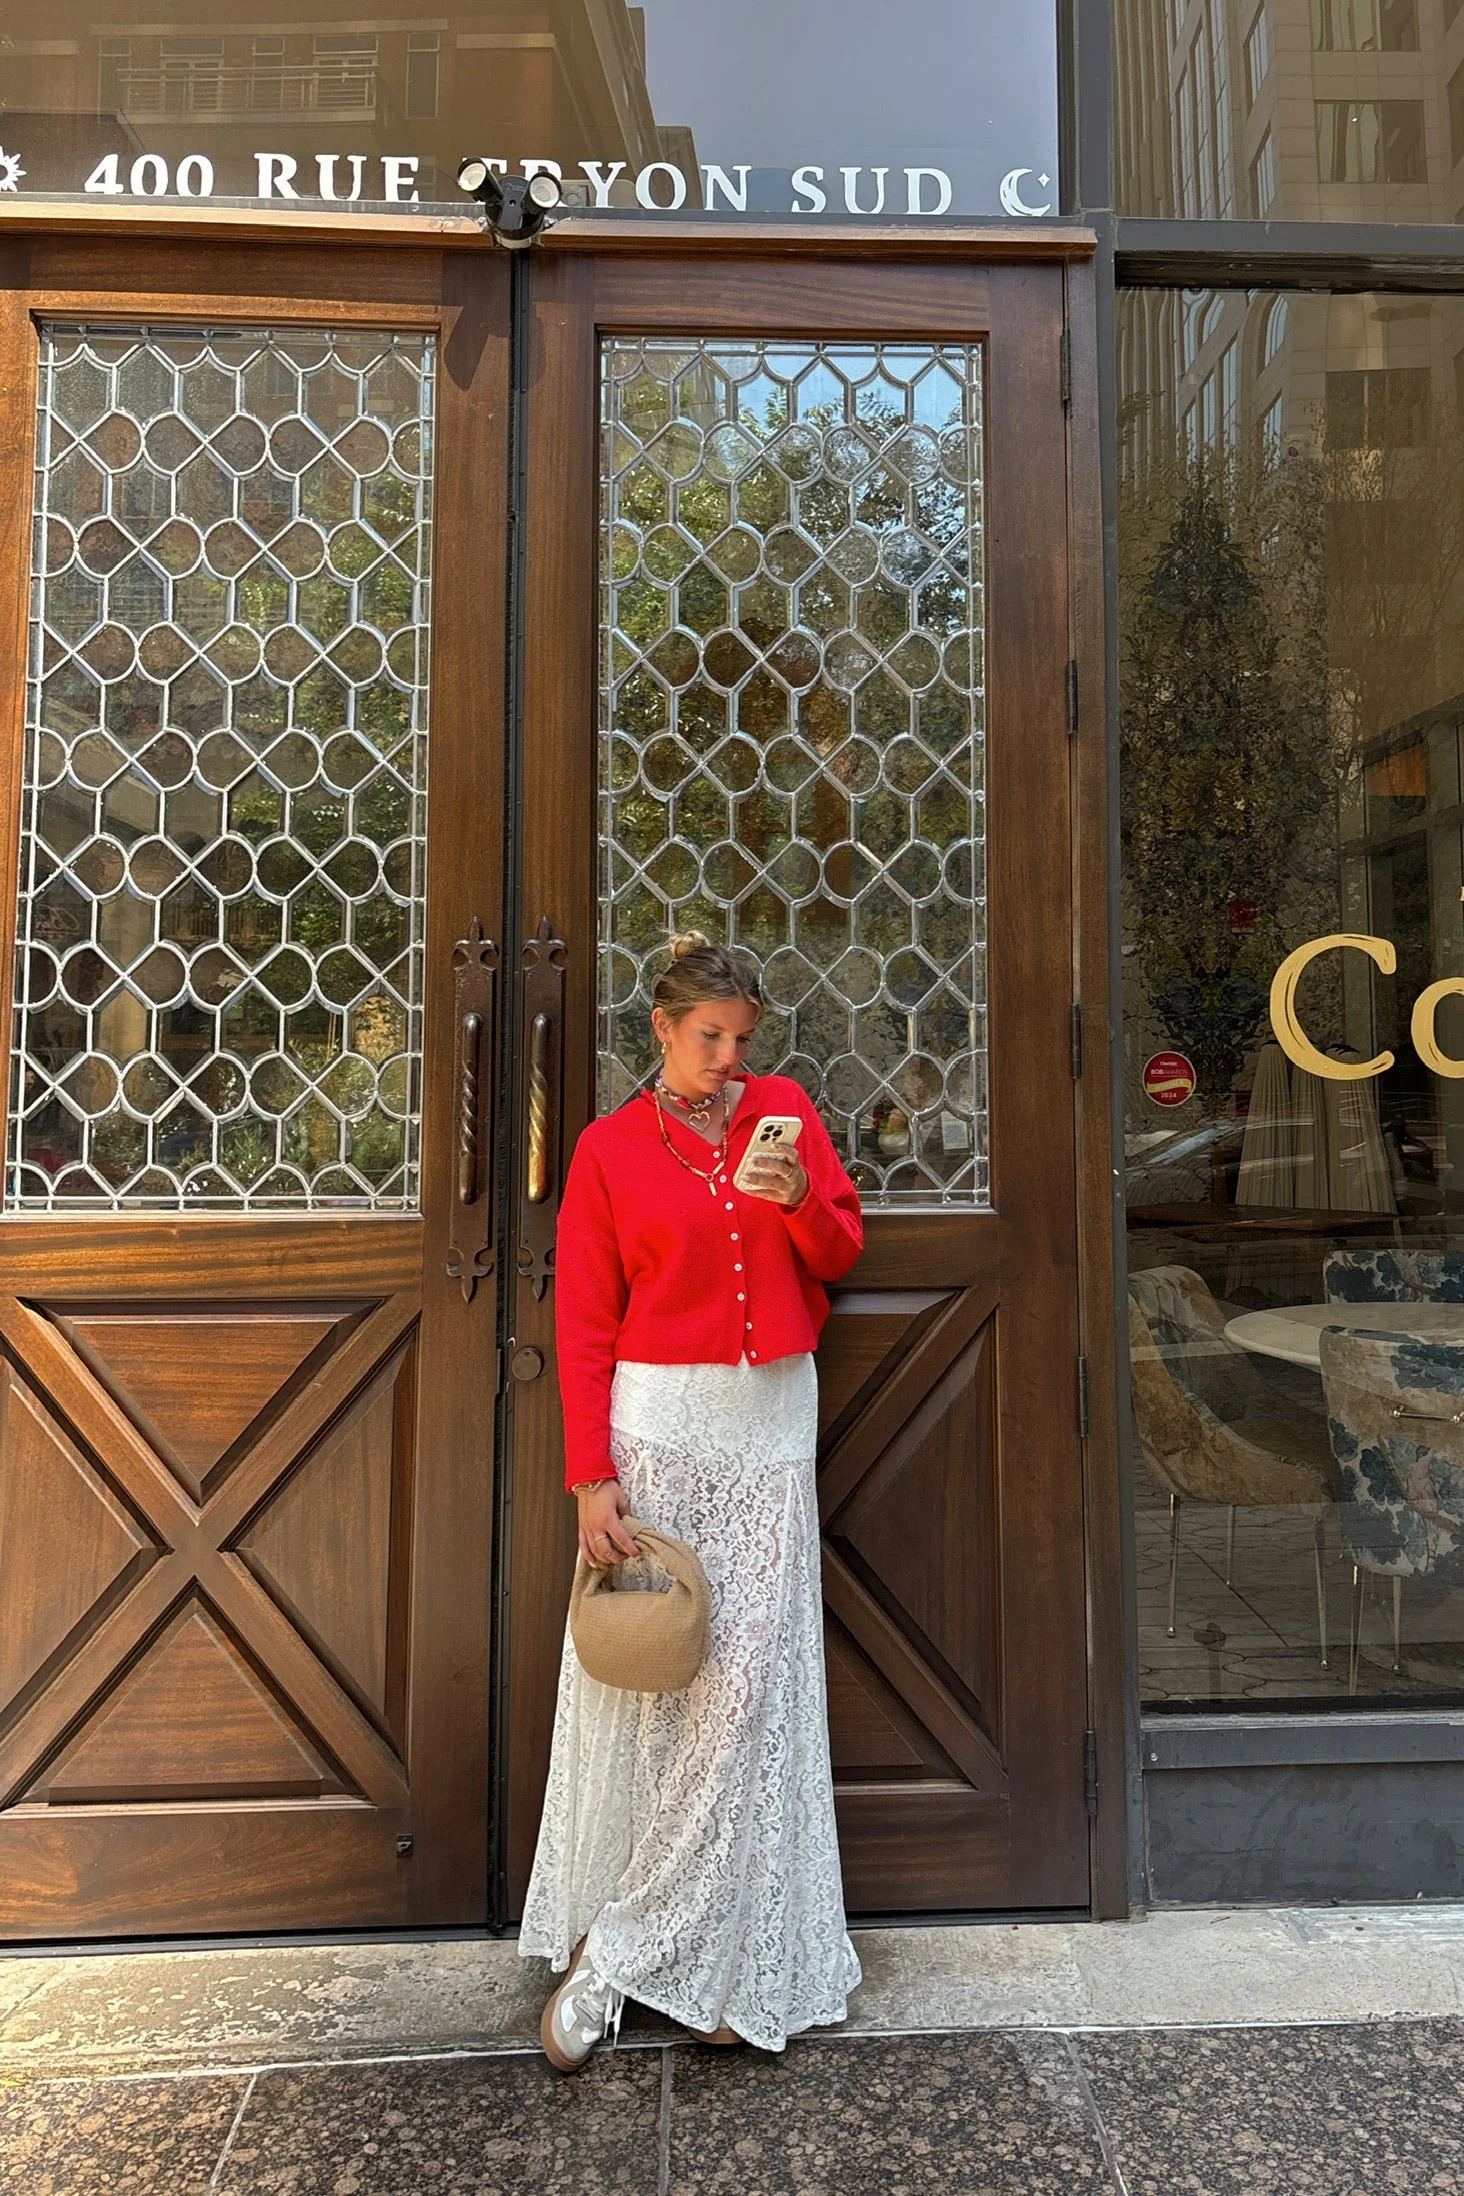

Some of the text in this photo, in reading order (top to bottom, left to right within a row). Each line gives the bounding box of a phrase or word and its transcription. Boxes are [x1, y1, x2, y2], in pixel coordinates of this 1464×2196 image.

[84, 153, 214, 197] 400
[253, 152, 419, 202] RUE
[791, 165, 953, 215] SUD
